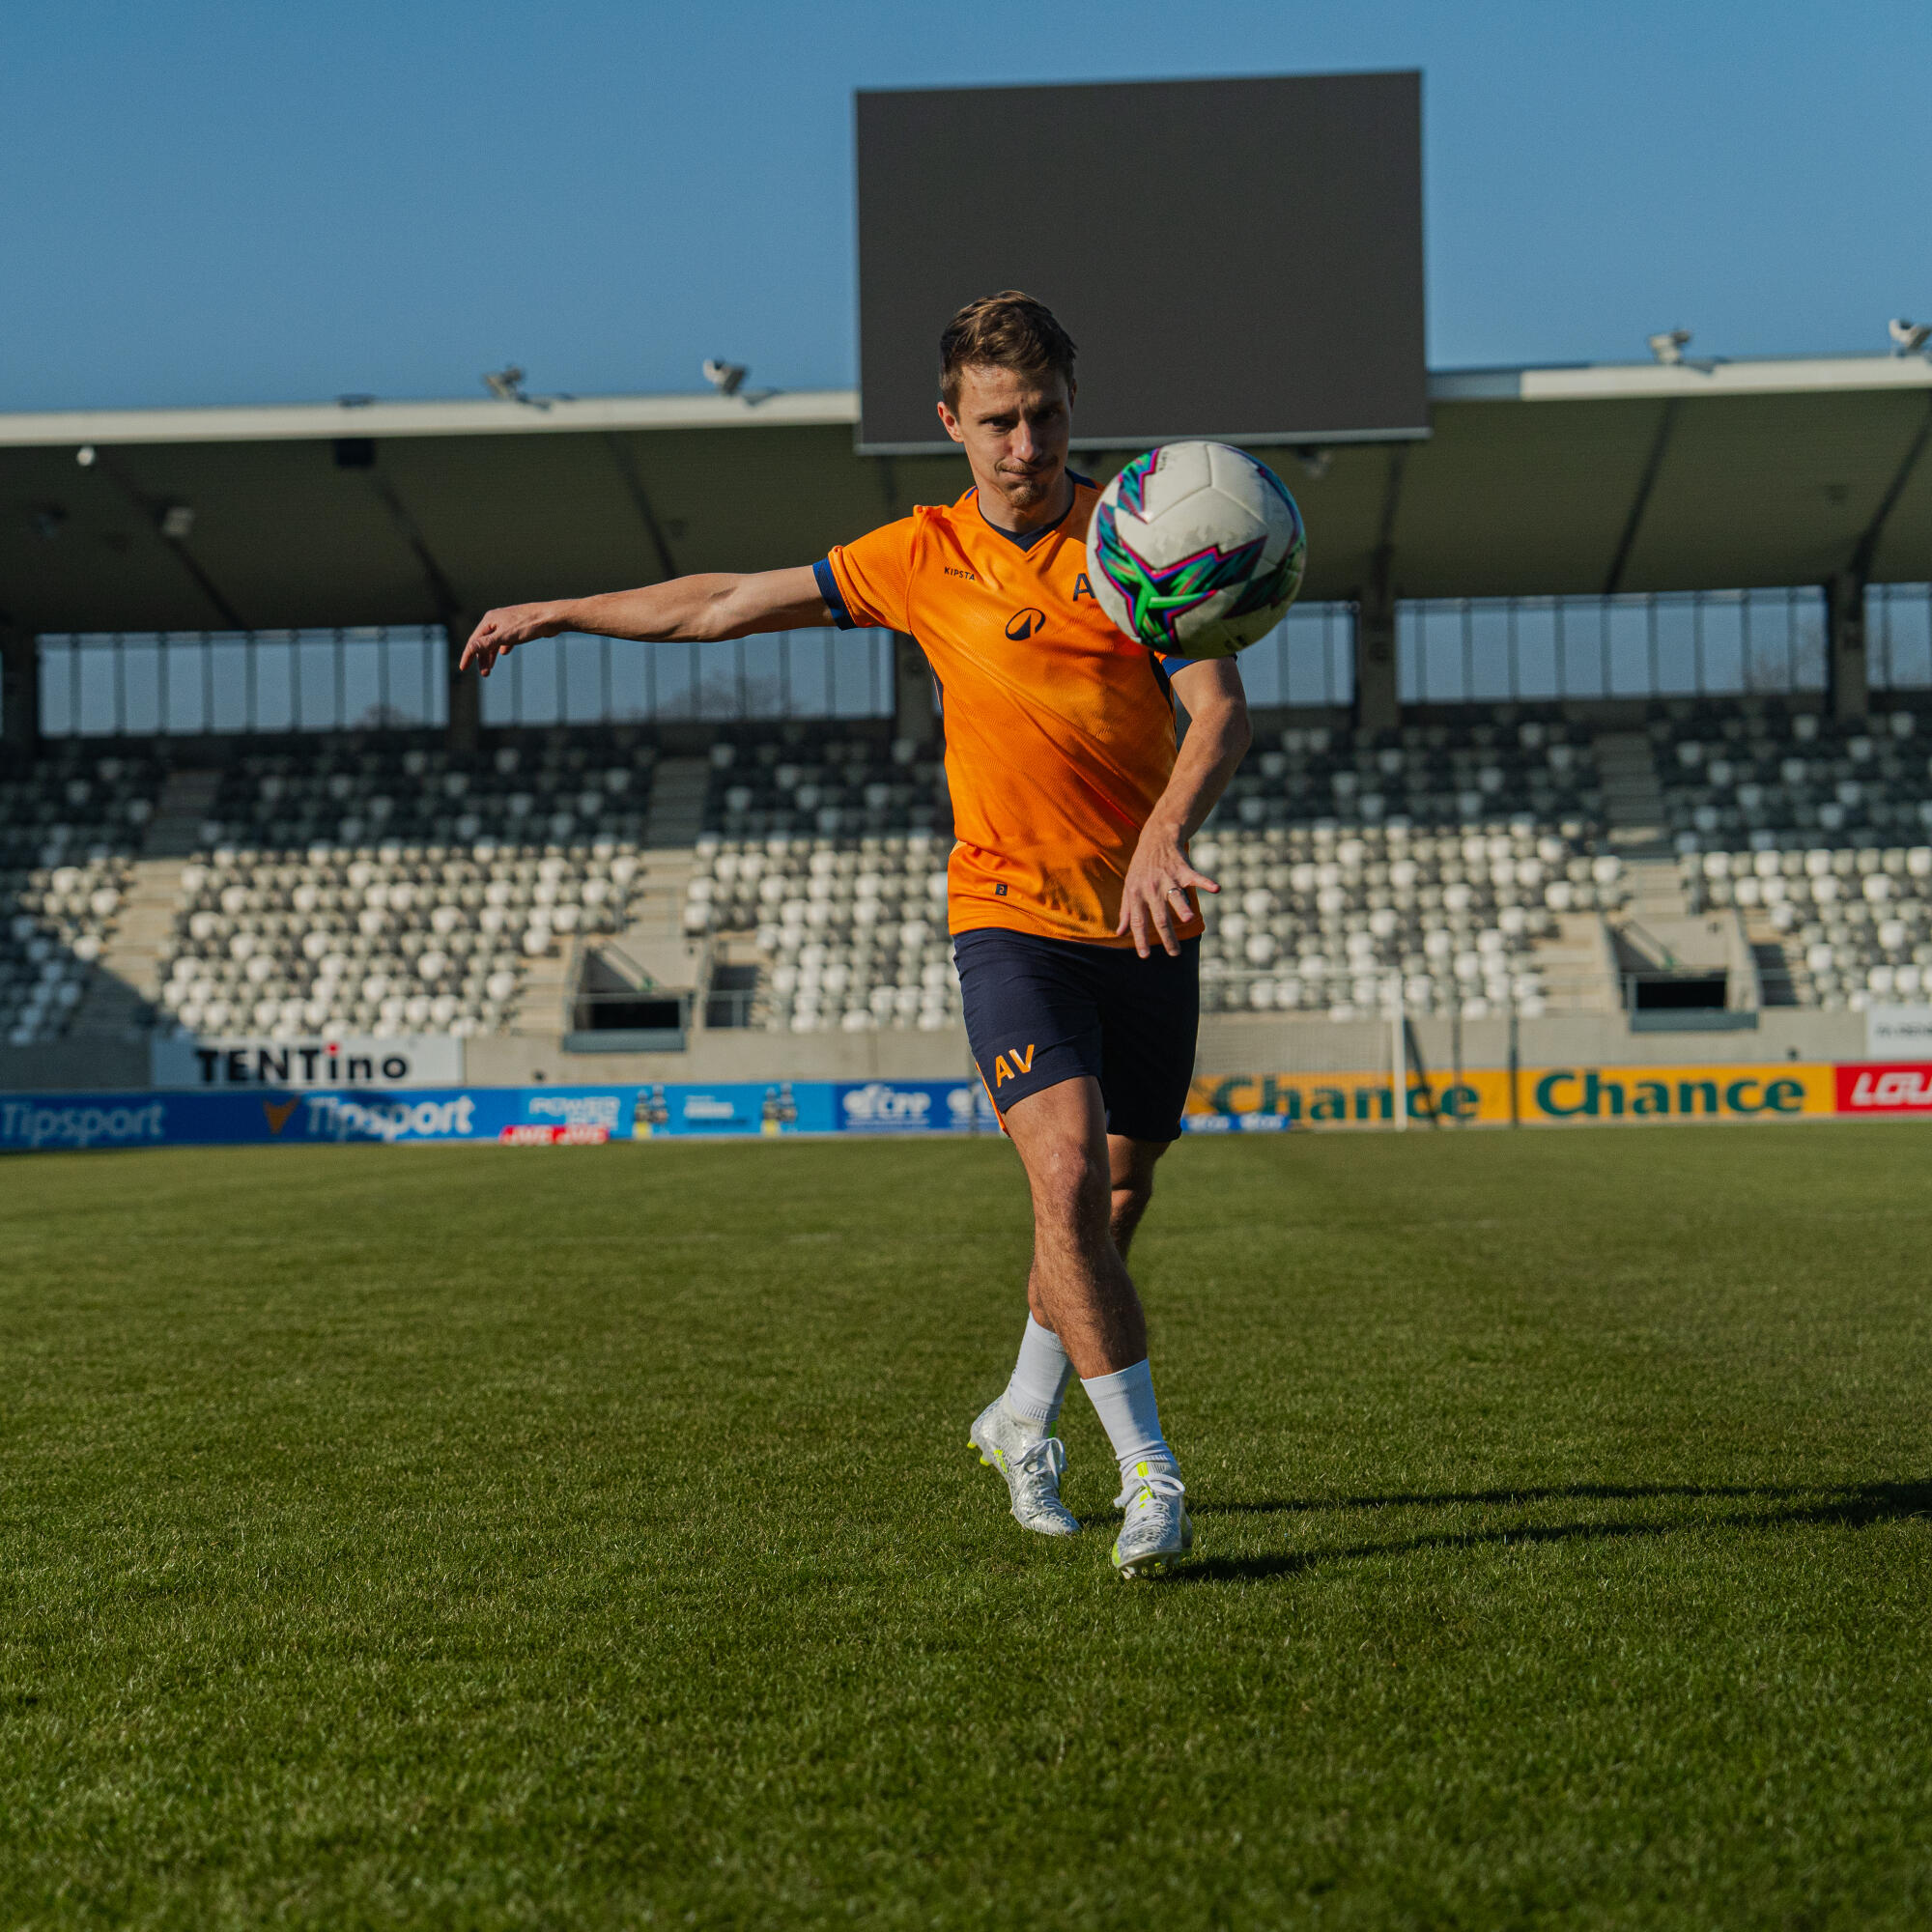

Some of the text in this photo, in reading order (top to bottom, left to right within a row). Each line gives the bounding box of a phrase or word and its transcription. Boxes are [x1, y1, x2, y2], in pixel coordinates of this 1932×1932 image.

[944, 566, 975, 581] KIPSTA
[196, 1042, 408, 1082] TENTino
[995, 1043, 1035, 1088] AV
[1212, 1075, 1479, 1121] Chance
[1535, 1069, 1805, 1117] Chance
[2, 1100, 164, 1148] Tipsport
[307, 1094, 475, 1141] Tipsport
